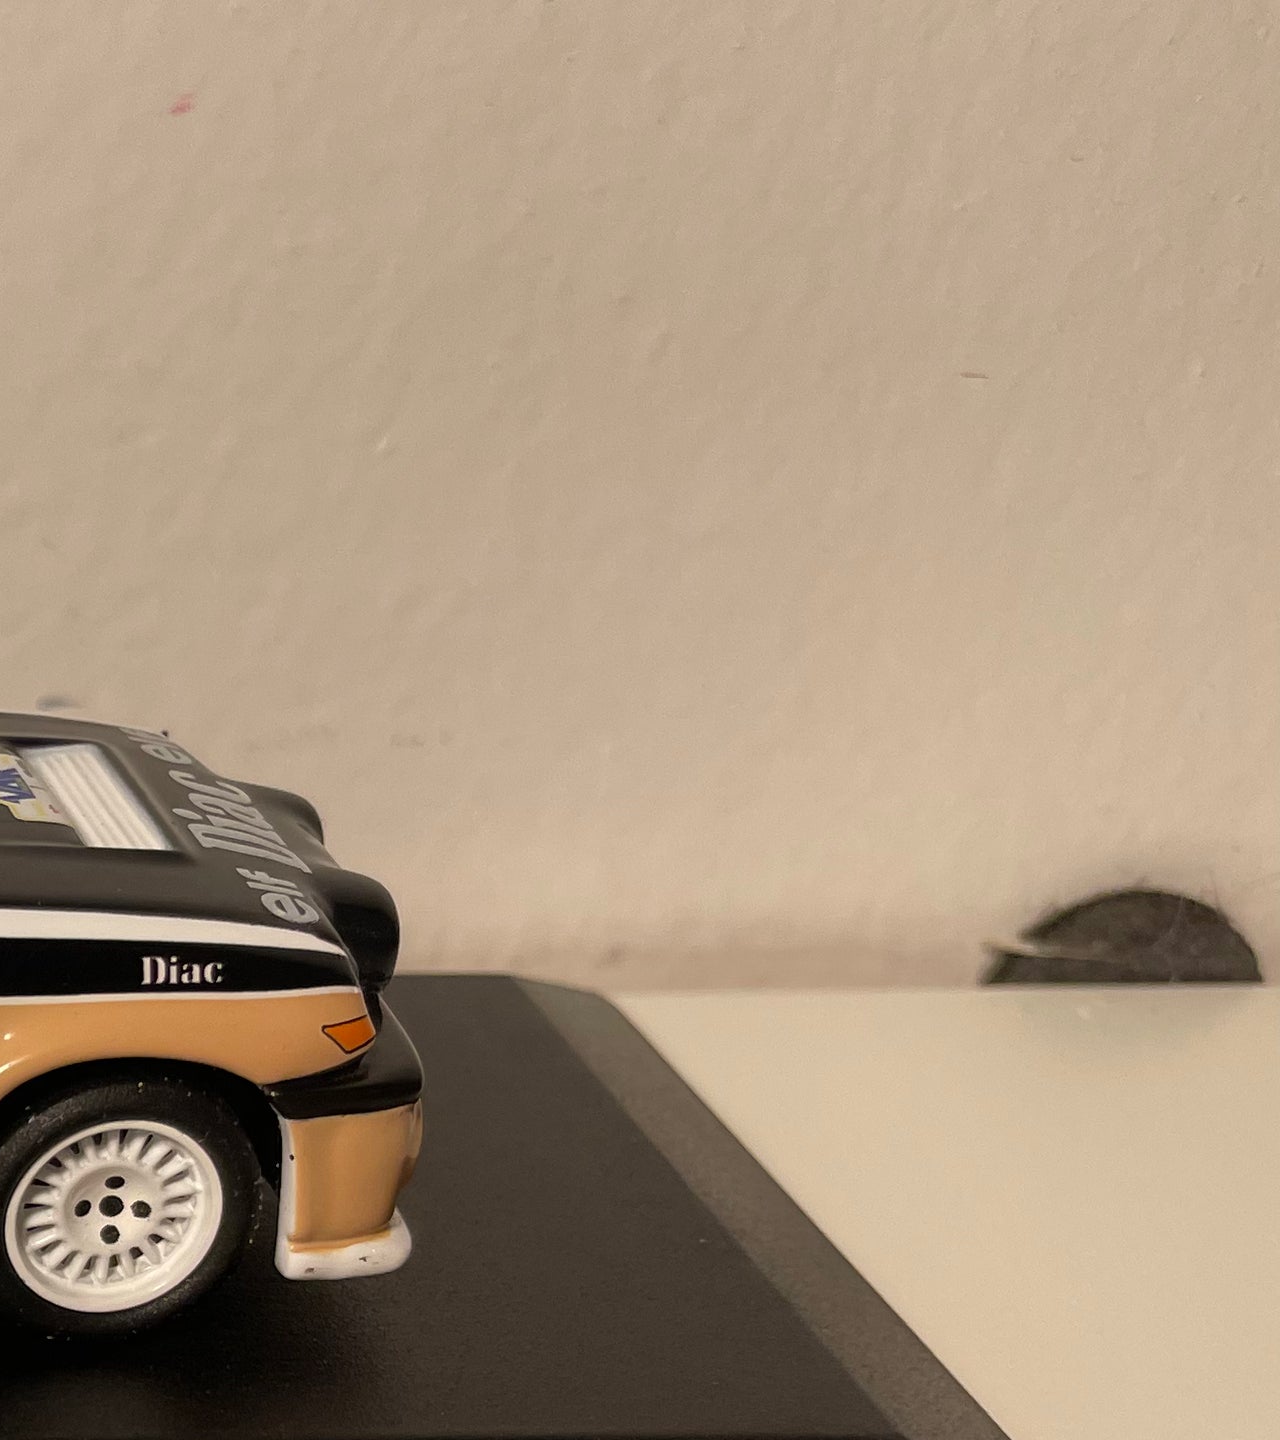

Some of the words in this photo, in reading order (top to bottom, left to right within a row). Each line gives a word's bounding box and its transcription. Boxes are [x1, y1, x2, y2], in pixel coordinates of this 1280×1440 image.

[168, 769, 313, 874] Diac
[235, 867, 320, 925] elf
[141, 955, 224, 986] Diac
